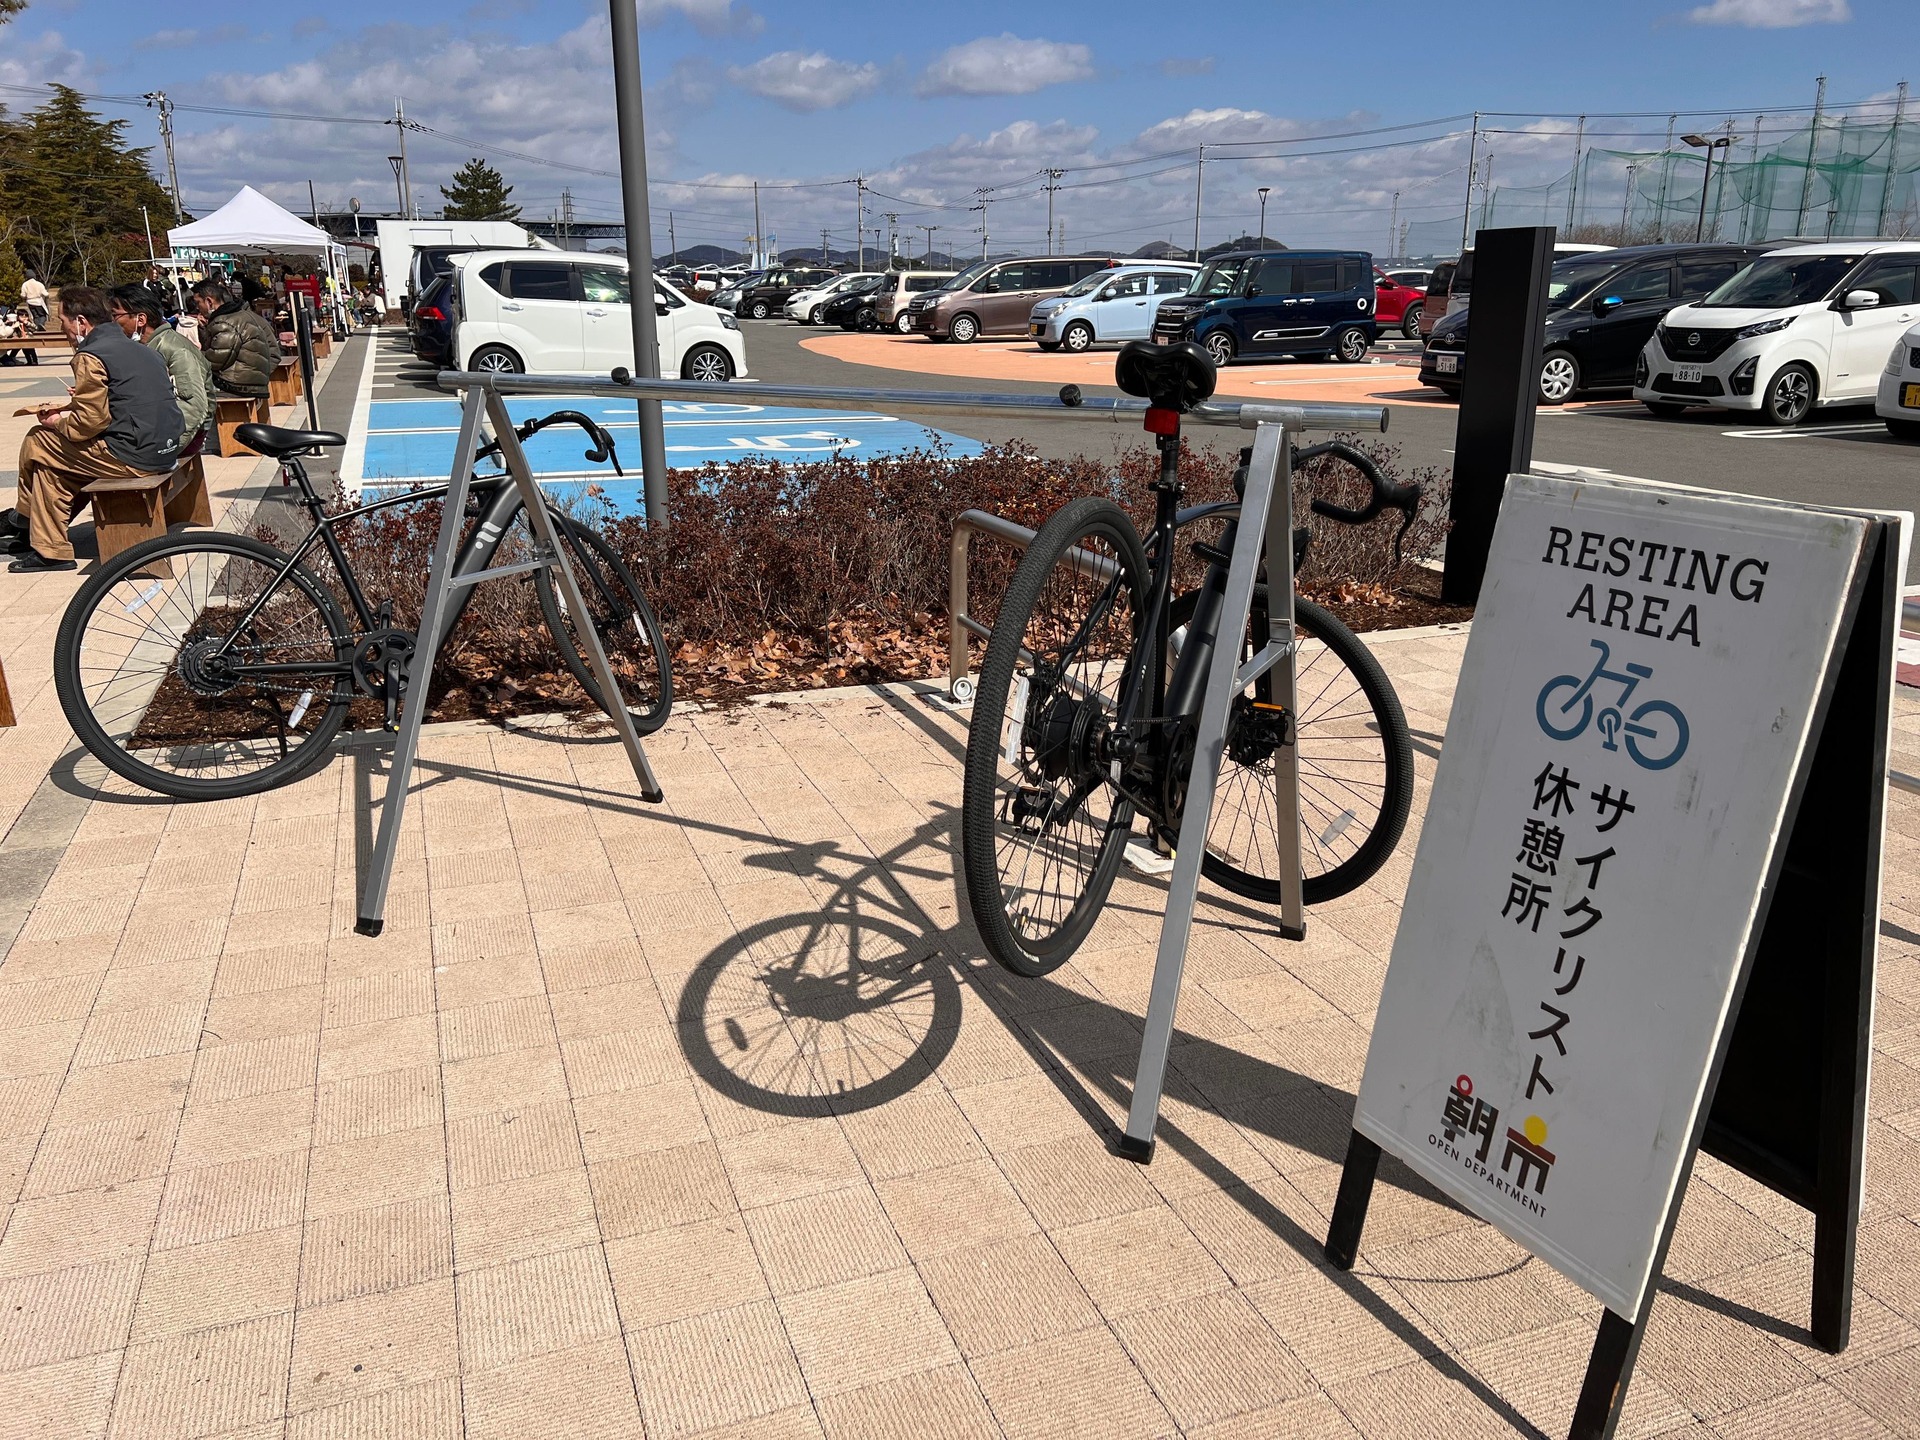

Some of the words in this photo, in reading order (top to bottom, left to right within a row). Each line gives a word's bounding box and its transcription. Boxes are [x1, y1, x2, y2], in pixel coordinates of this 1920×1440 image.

[1678, 370, 1701, 381] 88-10
[1541, 525, 1770, 604] RESTING
[1566, 583, 1701, 648] AREA
[1501, 761, 1581, 934] 休憩所
[1525, 783, 1637, 1100] サイクリスト
[1428, 1133, 1460, 1162] OPEN
[1464, 1157, 1547, 1218] DEPARTMENT
